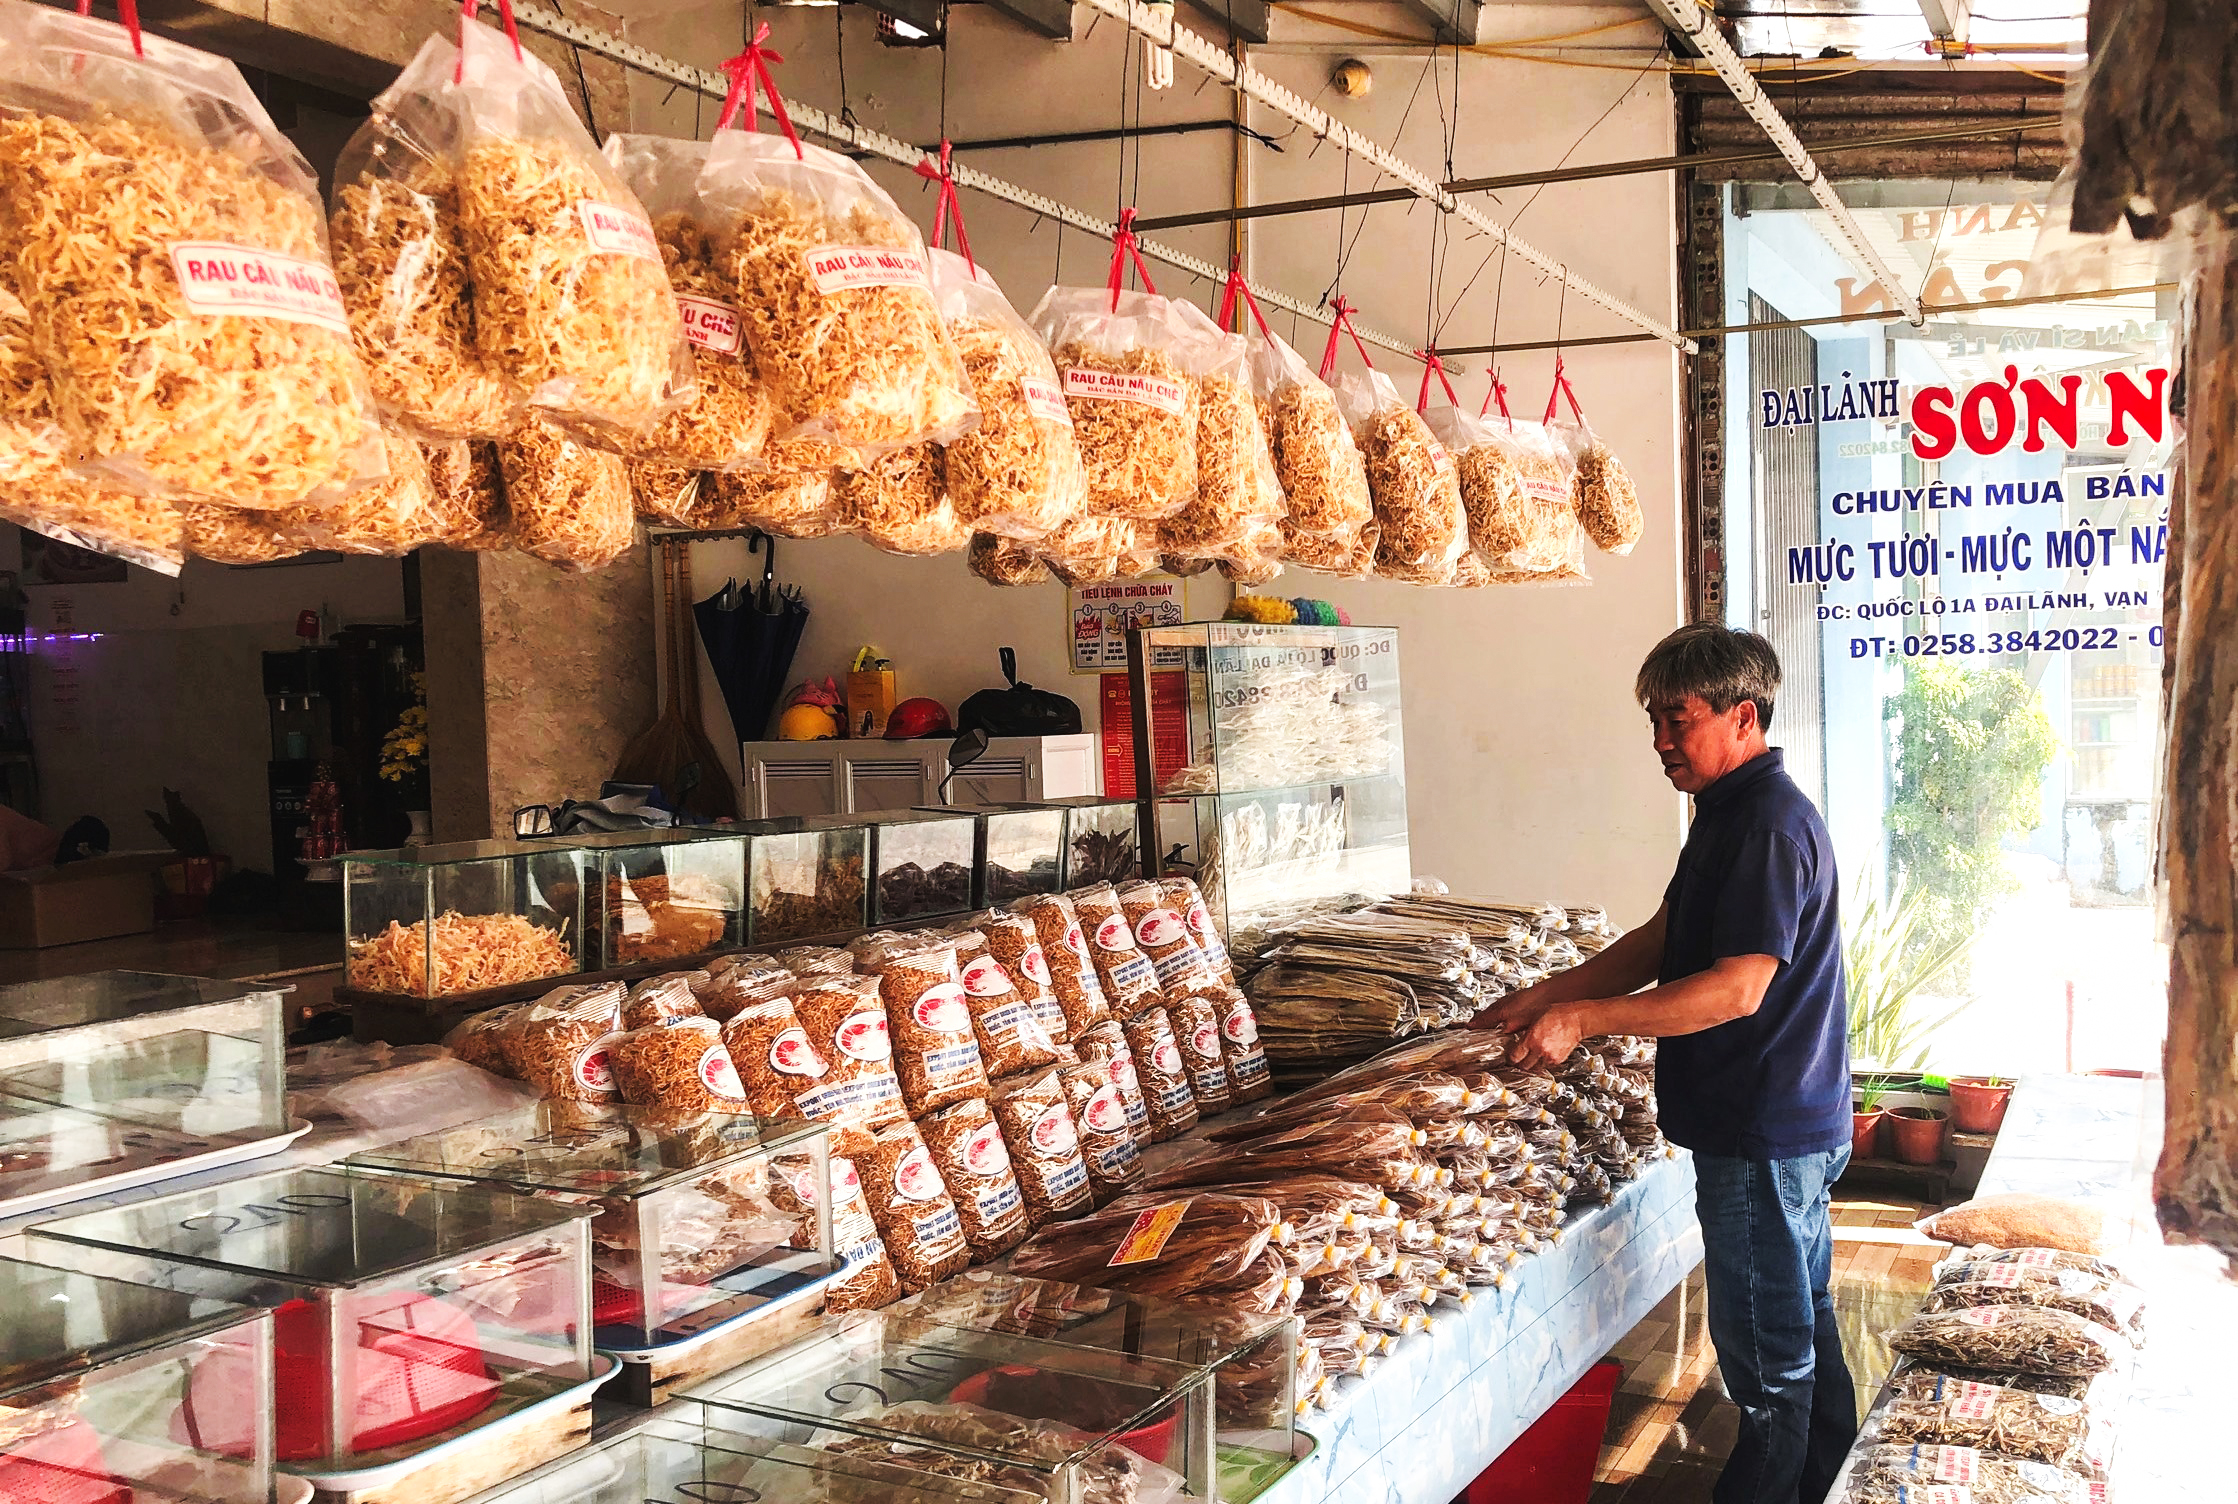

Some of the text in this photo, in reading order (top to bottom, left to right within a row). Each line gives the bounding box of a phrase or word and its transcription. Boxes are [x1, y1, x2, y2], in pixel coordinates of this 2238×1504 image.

[187, 260, 238, 282] RAU
[815, 256, 847, 276] RAU
[1071, 372, 1096, 385] RAU
[1156, 385, 1179, 401] CHÈ
[1762, 388, 1813, 435] ĐẠI
[1911, 364, 2082, 460] SƠN
[1832, 469, 2165, 514] CHUYÊN MUA BÁN
[1788, 537, 1855, 591] MỰC
[1868, 531, 1939, 579] TƯƠI
[1961, 526, 2032, 580] MỰC
[2046, 519, 2117, 576] MỘT
[1101, 585, 1123, 600] LỆNH
[1124, 583, 1148, 598] CHỮA
[1149, 582, 1173, 597] CHÁY
[1817, 590, 2149, 624] ĐC: QUỐC LỘ 1A ĐẠI LÃNH, VẠN
[1850, 637, 1896, 658] ĐT:
[1903, 627, 2119, 656] 0258.3842022
